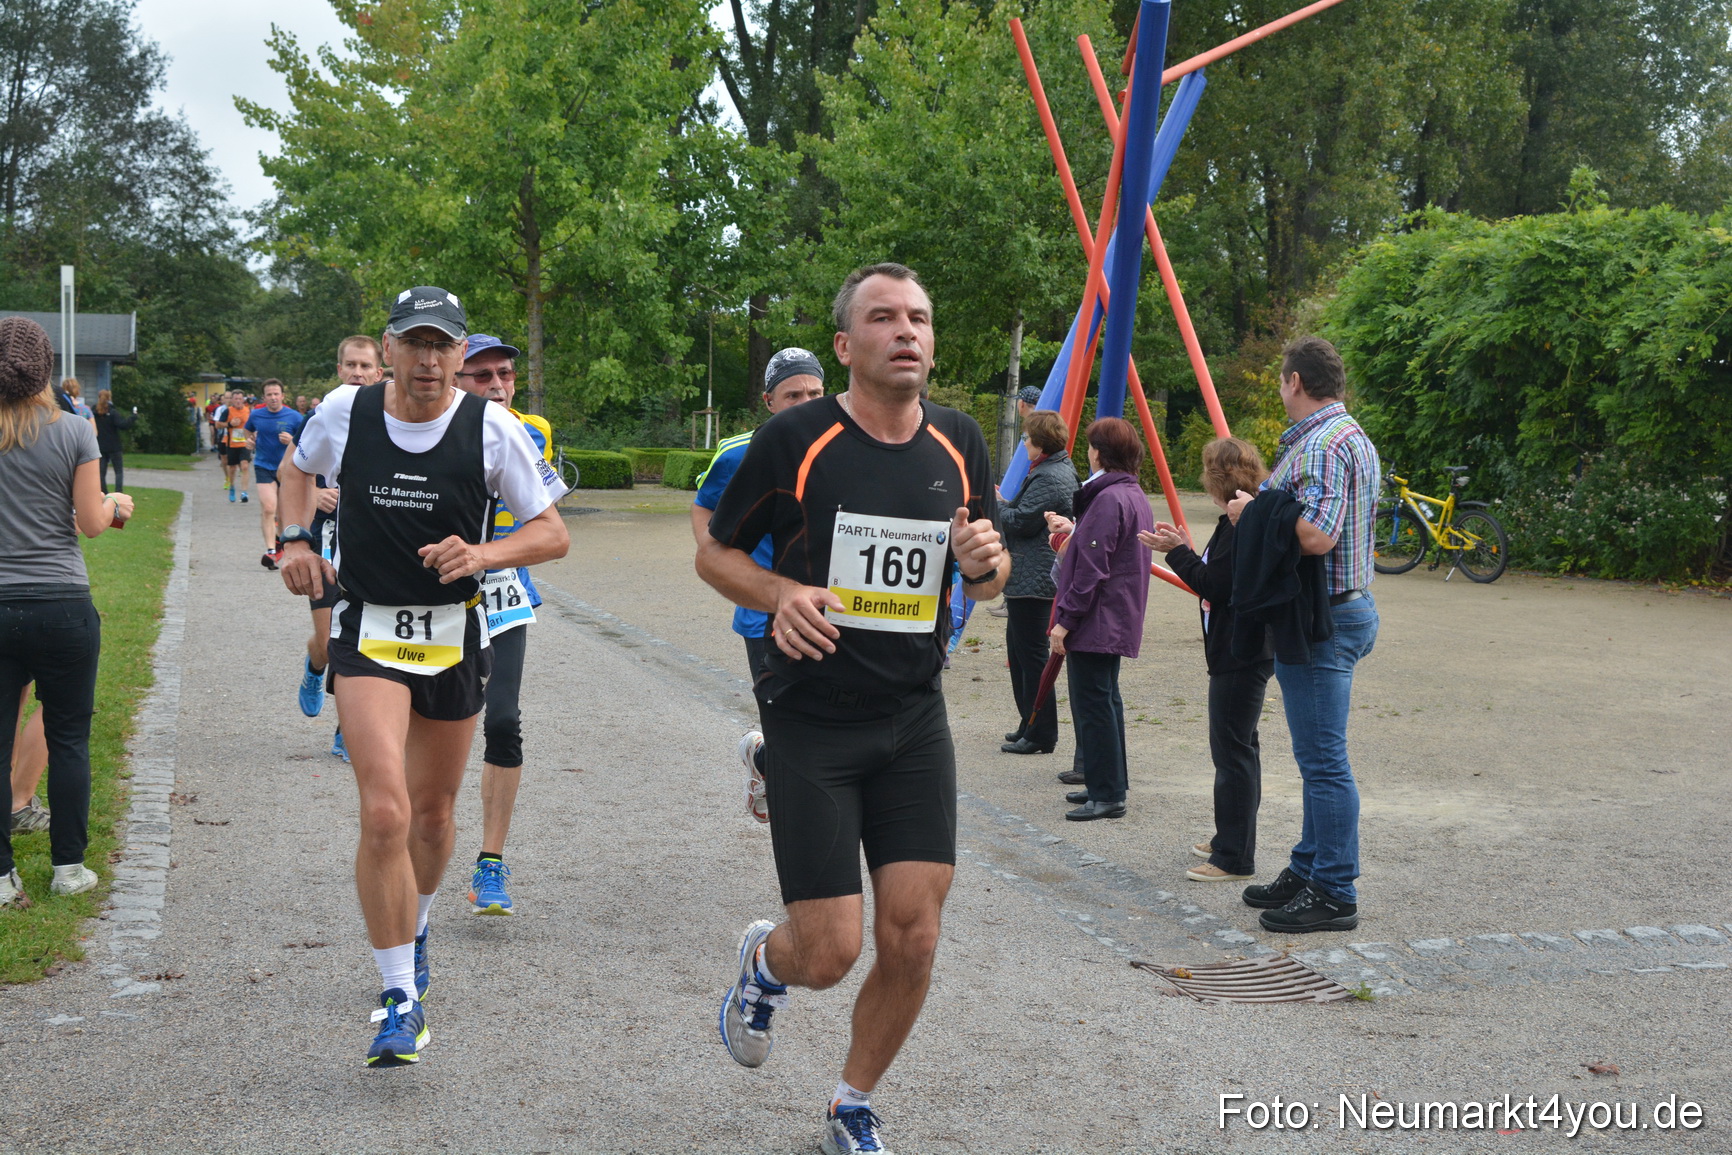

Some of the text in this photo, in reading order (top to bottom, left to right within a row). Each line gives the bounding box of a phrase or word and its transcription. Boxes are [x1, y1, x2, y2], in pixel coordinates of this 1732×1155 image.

[369, 485, 439, 500] LLC Marathon
[373, 496, 433, 511] Regensburg
[837, 524, 932, 543] PARTL Neumarkt
[859, 544, 926, 588] 169
[483, 584, 522, 612] 18
[853, 596, 920, 616] Bernhard
[395, 610, 432, 640] 81
[487, 615, 503, 629] ari
[397, 647, 425, 662] Uwe
